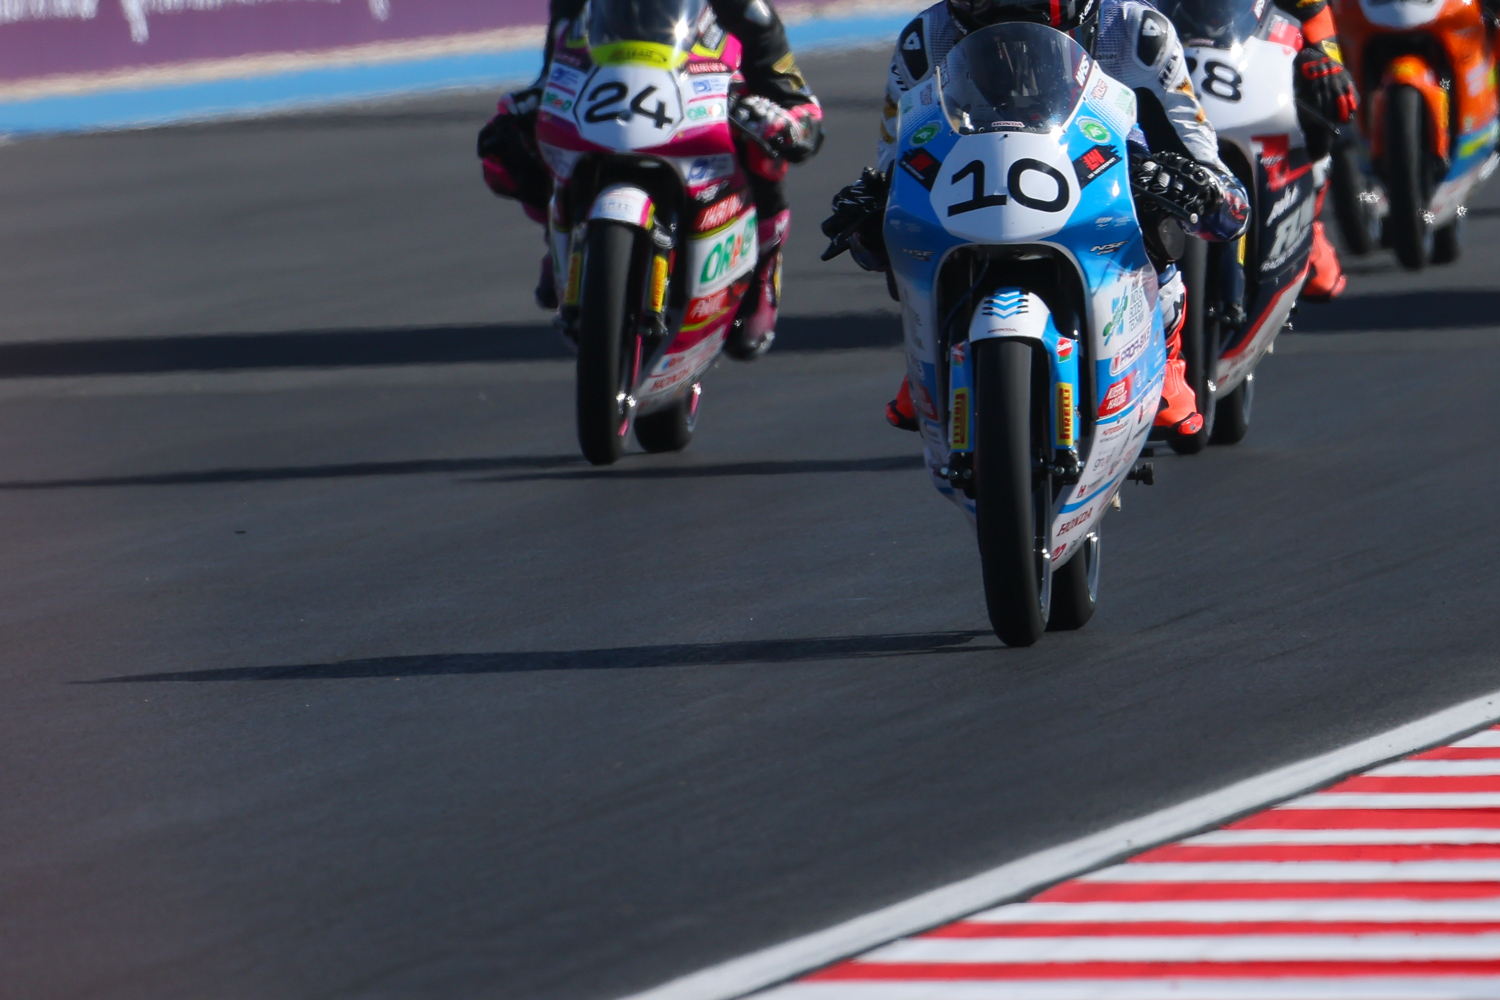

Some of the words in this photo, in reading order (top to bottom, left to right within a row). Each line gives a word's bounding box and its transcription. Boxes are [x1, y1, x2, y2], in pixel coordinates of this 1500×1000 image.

[584, 81, 674, 129] 24
[947, 158, 1070, 218] 10
[1090, 240, 1128, 252] NSF
[954, 393, 966, 444] PIRELLI
[1059, 387, 1070, 440] PIRELLI
[1056, 507, 1093, 537] HONDA
